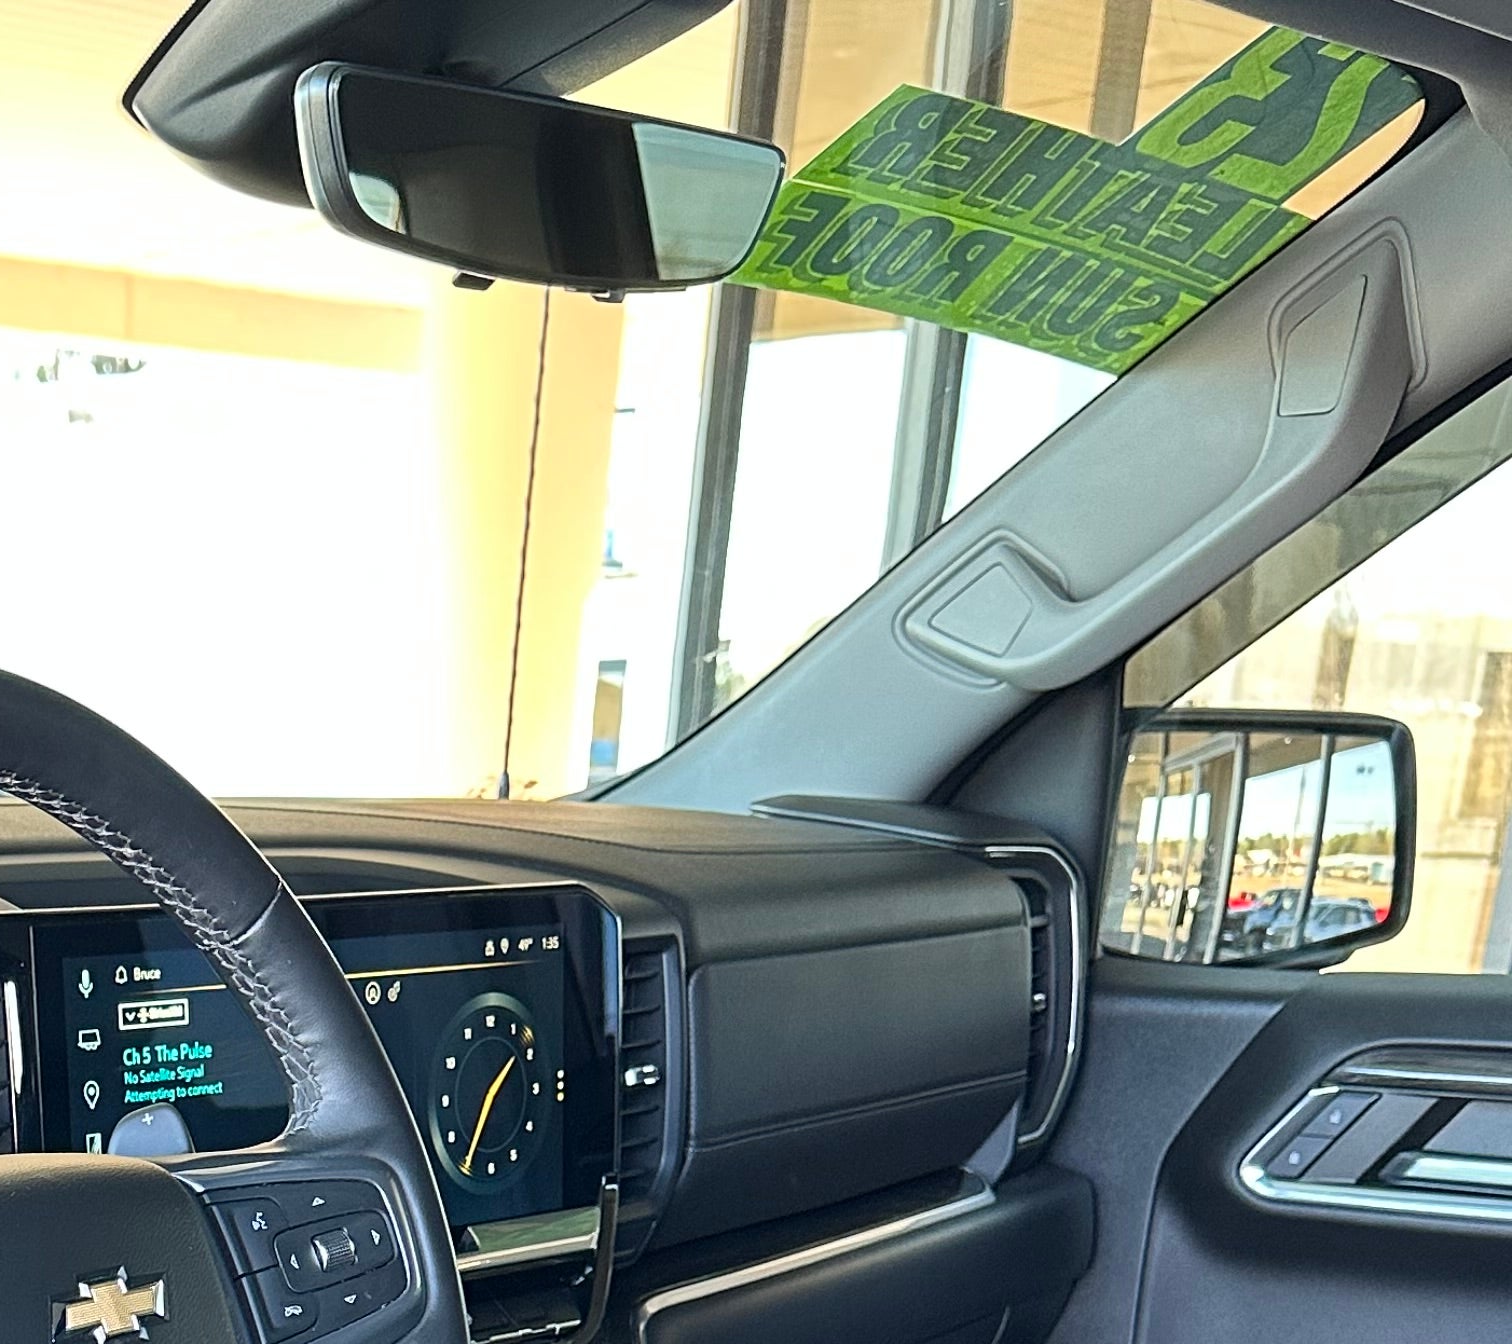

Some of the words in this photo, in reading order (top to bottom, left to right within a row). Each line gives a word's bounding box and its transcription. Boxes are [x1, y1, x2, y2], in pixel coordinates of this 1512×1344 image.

[133, 966, 162, 981] Bruce
[122, 1047, 141, 1066] Ch
[142, 1046, 151, 1065] 5
[154, 1044, 179, 1063] The
[180, 1041, 213, 1060] Pulse
[123, 1071, 139, 1085] No
[139, 1067, 176, 1084] Satellite
[177, 1063, 205, 1082] Signal
[124, 1087, 176, 1104] Attempting
[176, 1085, 187, 1098] to
[187, 1081, 224, 1097] connect
